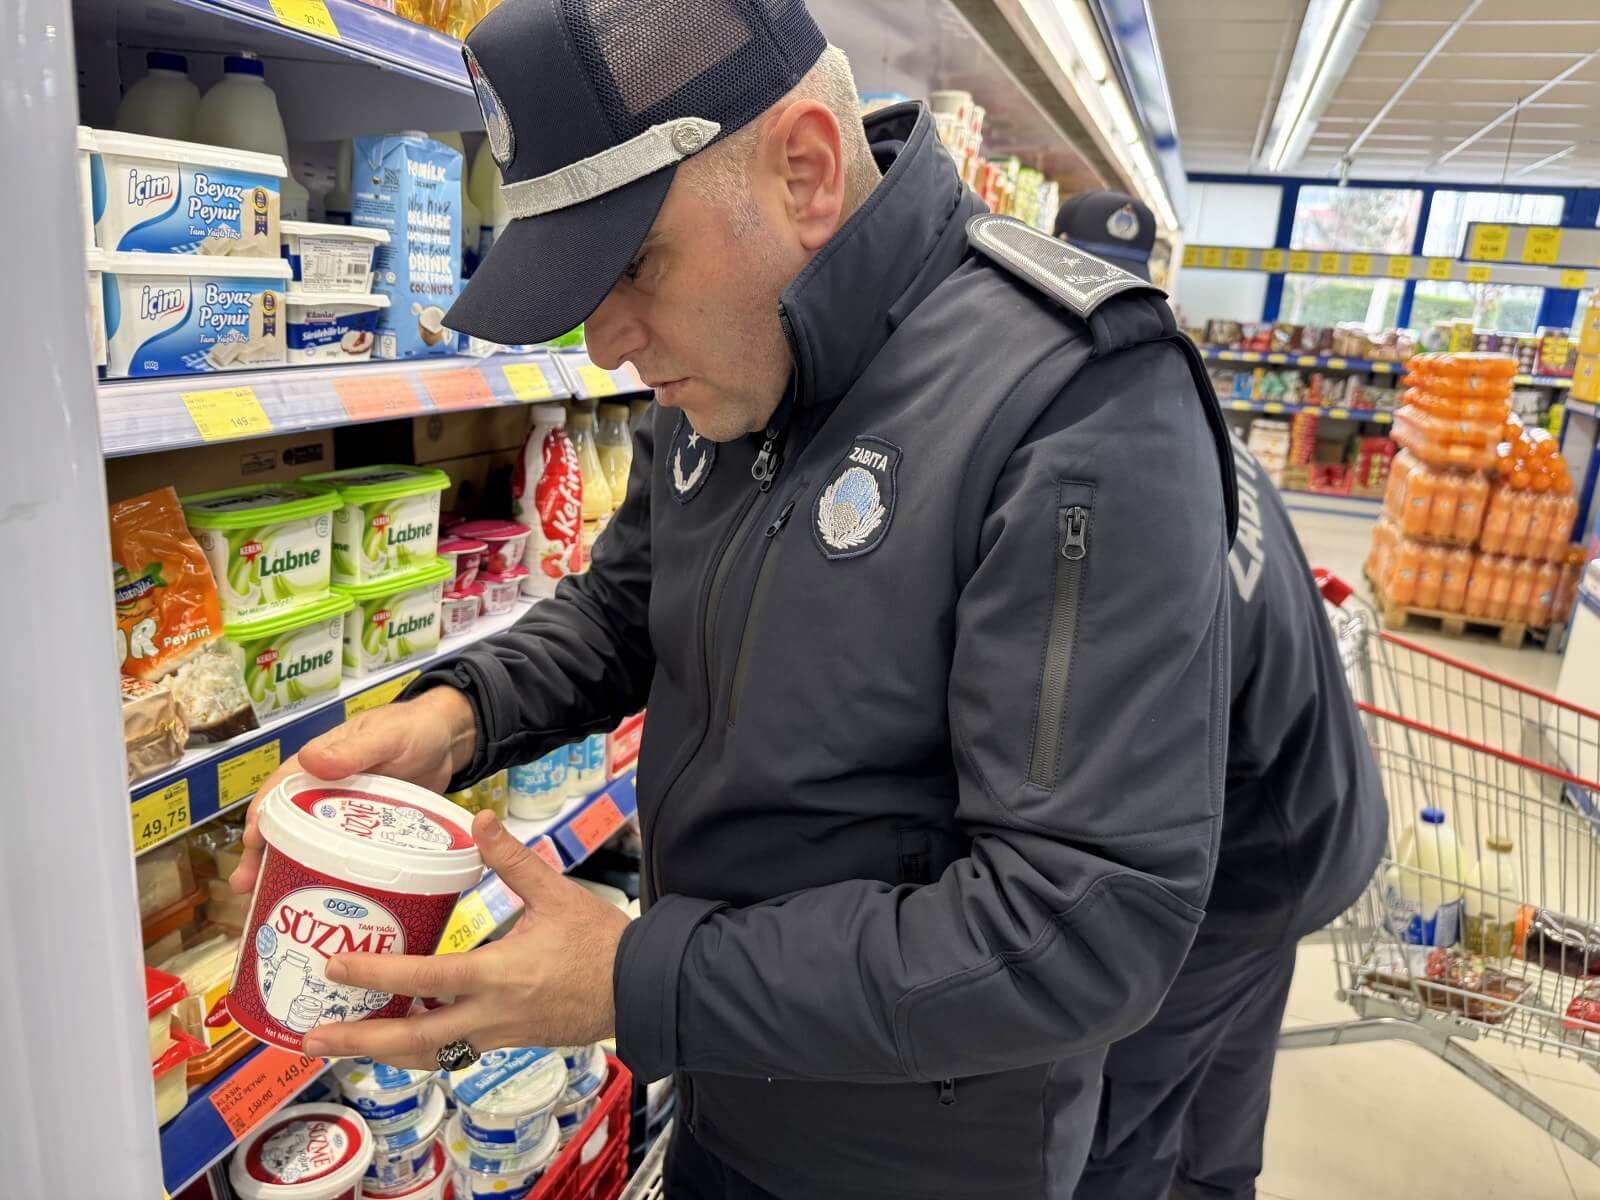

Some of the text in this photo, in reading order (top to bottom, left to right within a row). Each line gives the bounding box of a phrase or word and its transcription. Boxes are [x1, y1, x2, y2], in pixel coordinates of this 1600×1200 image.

[128, 168, 170, 206] İçim
[194, 172, 243, 202] Beyaz
[188, 197, 240, 224] Peynir
[189, 226, 205, 236] Tam
[408, 255, 452, 273] DRINK
[205, 282, 253, 309] Beyaz
[410, 282, 453, 295] COCONUTS
[141, 284, 182, 321] İçim
[199, 306, 249, 331] Peynir
[200, 334, 214, 343] Tam
[849, 447, 888, 472] ZABITA
[387, 521, 433, 546] Labne
[259, 549, 321, 577] Labne
[163, 625, 211, 648] Peyniri
[387, 611, 435, 640] Labne
[275, 649, 333, 683] Labne
[142, 806, 186, 839] 49,75
[327, 899, 360, 916] DOST
[275, 905, 397, 960] SÜZME
[358, 923, 374, 932] TAM
[450, 914, 486, 948] 279,00
[265, 1027, 276, 1039] Net
